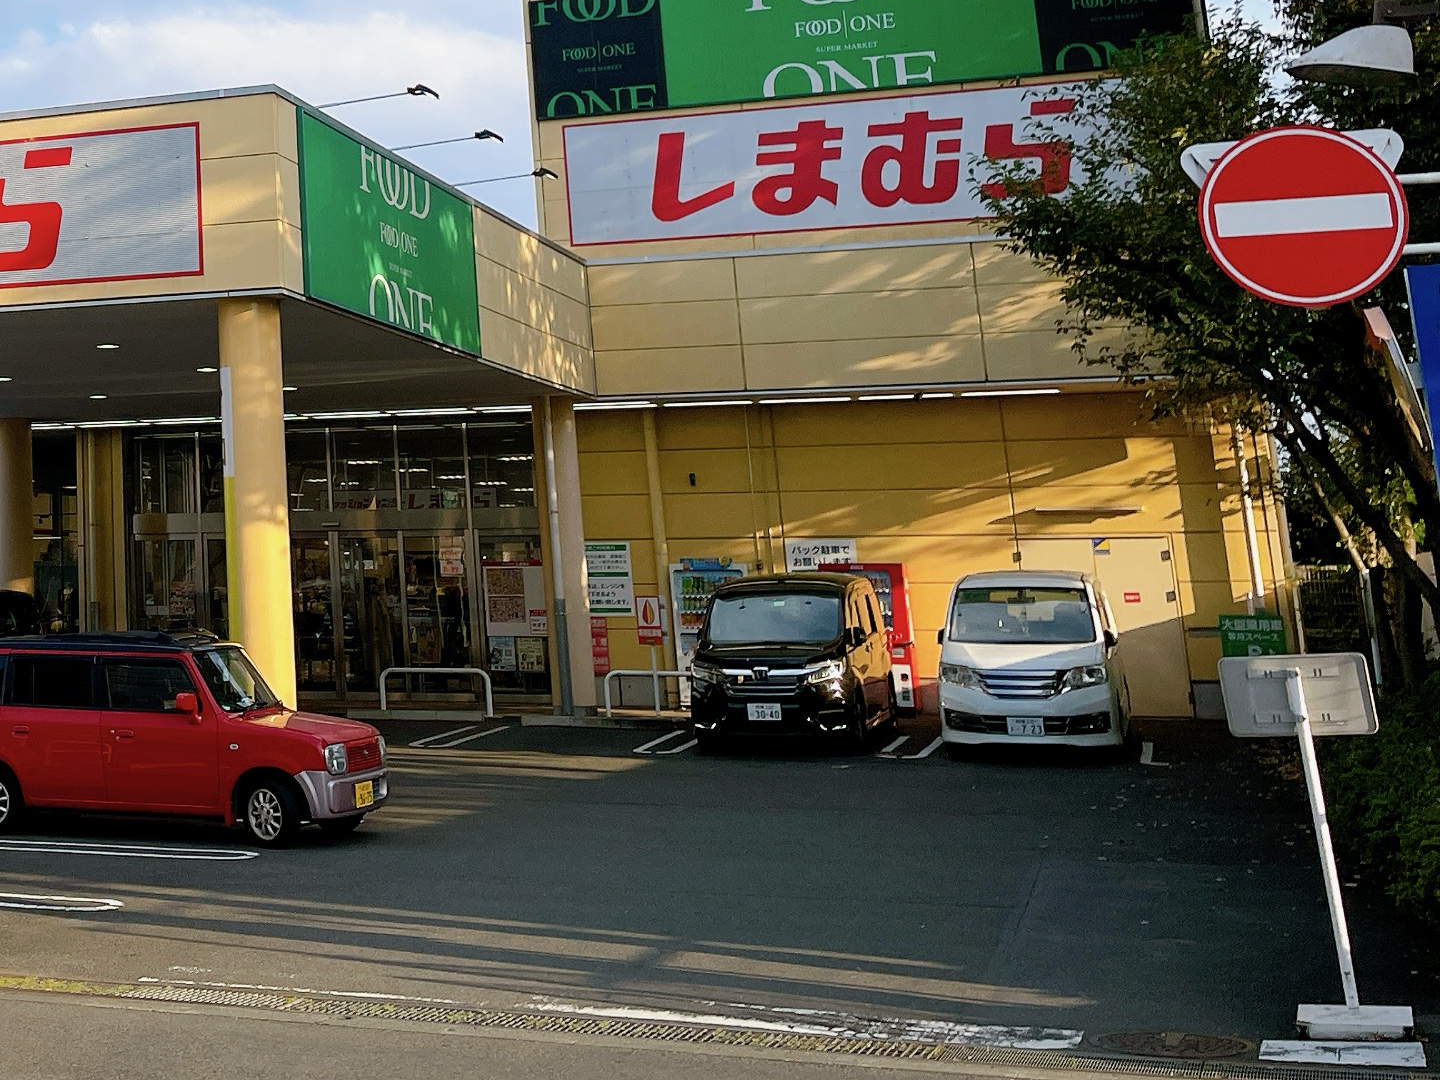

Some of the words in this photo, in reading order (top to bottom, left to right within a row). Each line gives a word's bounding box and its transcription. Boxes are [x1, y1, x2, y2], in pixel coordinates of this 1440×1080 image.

[795, 18, 842, 38] FOOD
[849, 13, 896, 31] ONE
[562, 46, 596, 61] FOOD
[602, 43, 636, 57] ONE
[815, 44, 842, 53] SUPER
[844, 41, 878, 51] MARKET
[762, 50, 937, 98] ONE
[546, 84, 657, 117] ONE
[651, 98, 1075, 222] しまむら
[380, 222, 398, 249] FOOD
[401, 232, 418, 258] ONE
[369, 274, 433, 335] ONE
[791, 545, 850, 555] バック駐車で
